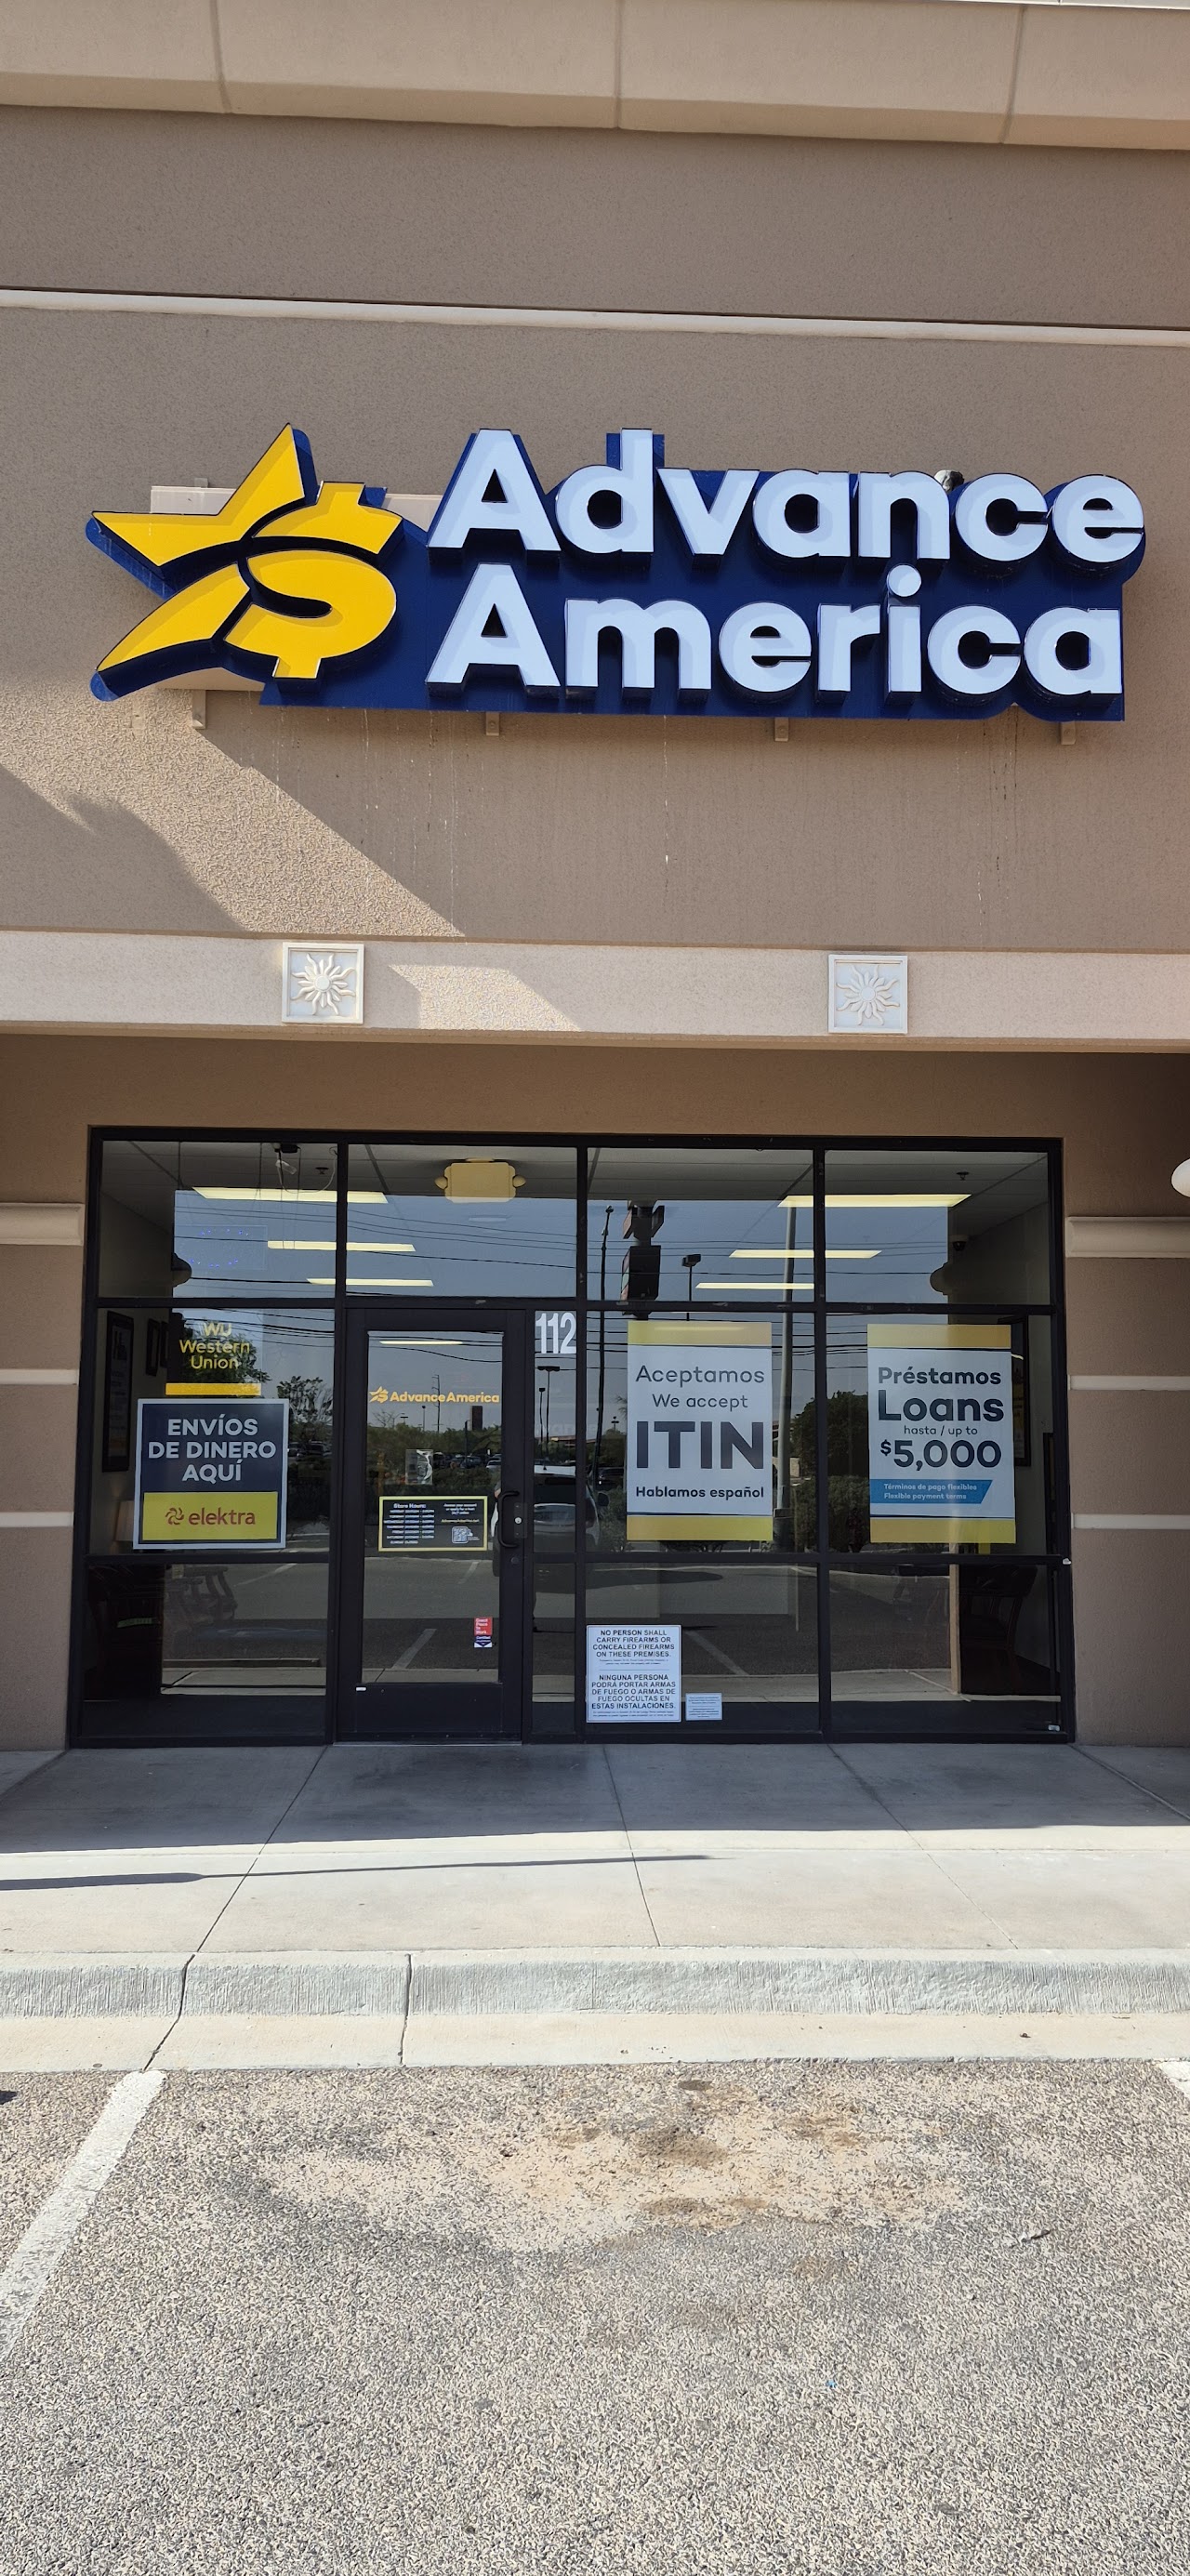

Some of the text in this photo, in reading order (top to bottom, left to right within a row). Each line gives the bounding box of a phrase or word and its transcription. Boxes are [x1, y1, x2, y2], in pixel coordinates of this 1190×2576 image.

[427, 429, 1144, 563] Advance
[427, 562, 1122, 697] America
[203, 1322, 232, 1337] WU
[536, 1312, 576, 1354] 112
[178, 1340, 250, 1354] Western
[191, 1354, 239, 1369] Union
[635, 1365, 765, 1388] Aceptamos
[878, 1366, 1001, 1385] Préstamos
[390, 1391, 500, 1403] Advance America
[653, 1394, 748, 1412] We accept
[878, 1389, 1005, 1422] Loans
[167, 1413, 258, 1436] ENVÍOS
[904, 1425, 937, 1435] hasta
[948, 1427, 962, 1437] up
[965, 1426, 978, 1435] to
[148, 1441, 277, 1459] DE DINERO
[636, 1420, 764, 1470] ITIN
[880, 1439, 1002, 1472] $5,000
[181, 1460, 243, 1484] AQUÍ
[636, 1486, 764, 1500] Hablamos español
[912, 1493, 945, 1501] payment
[188, 1507, 256, 1526] elektra
